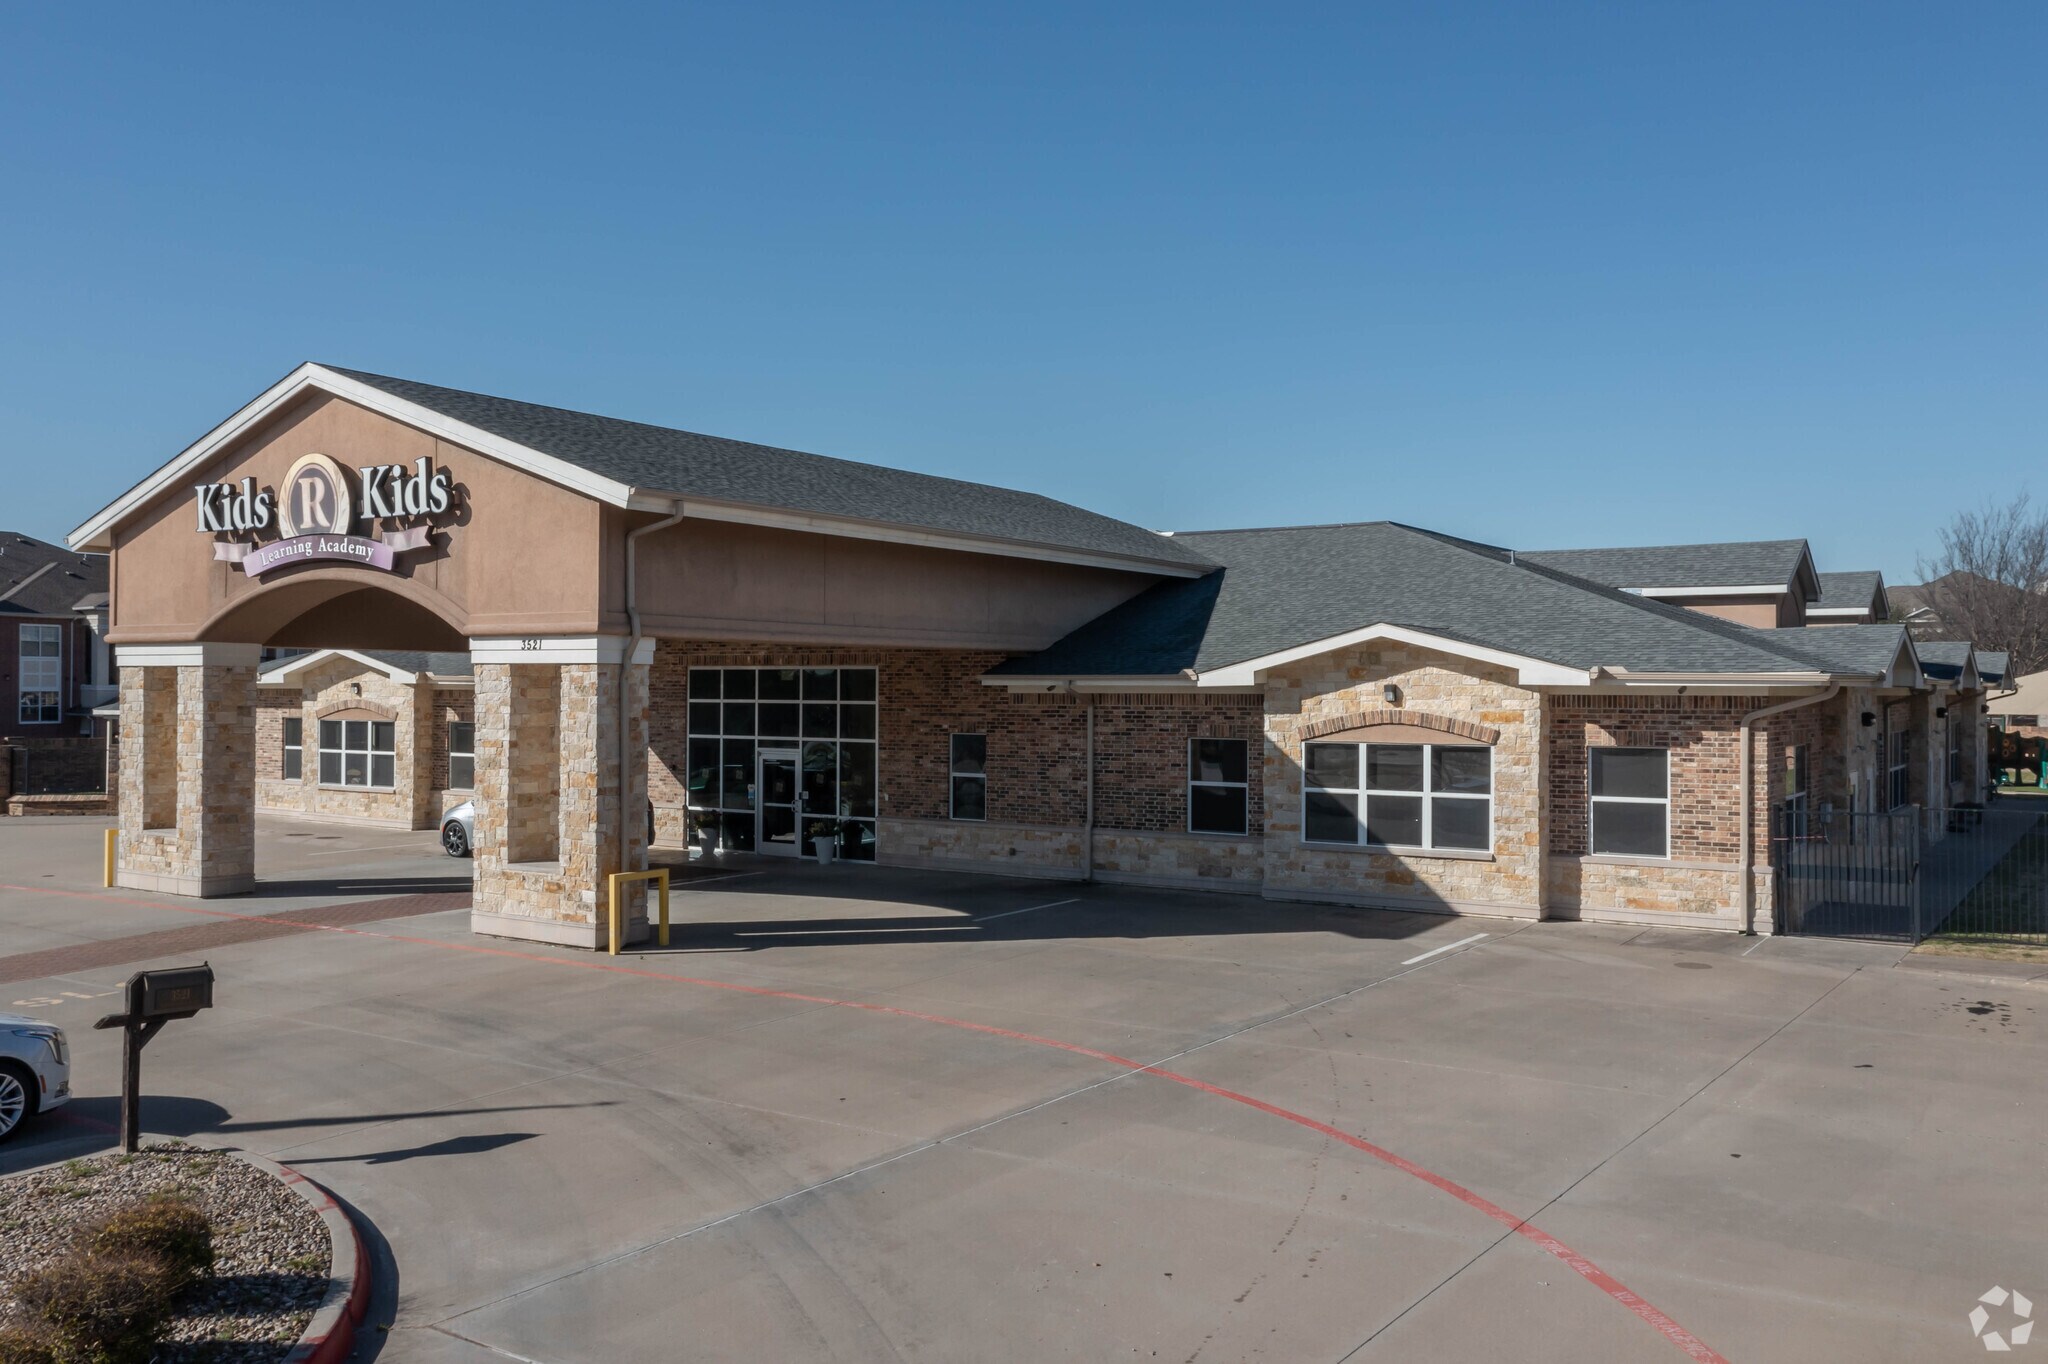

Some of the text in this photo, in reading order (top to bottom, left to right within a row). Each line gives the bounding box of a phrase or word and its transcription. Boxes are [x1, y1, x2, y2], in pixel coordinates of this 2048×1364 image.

[195, 456, 449, 533] Kids R Kids
[261, 537, 375, 566] Learning Academy
[521, 639, 543, 651] 3521
